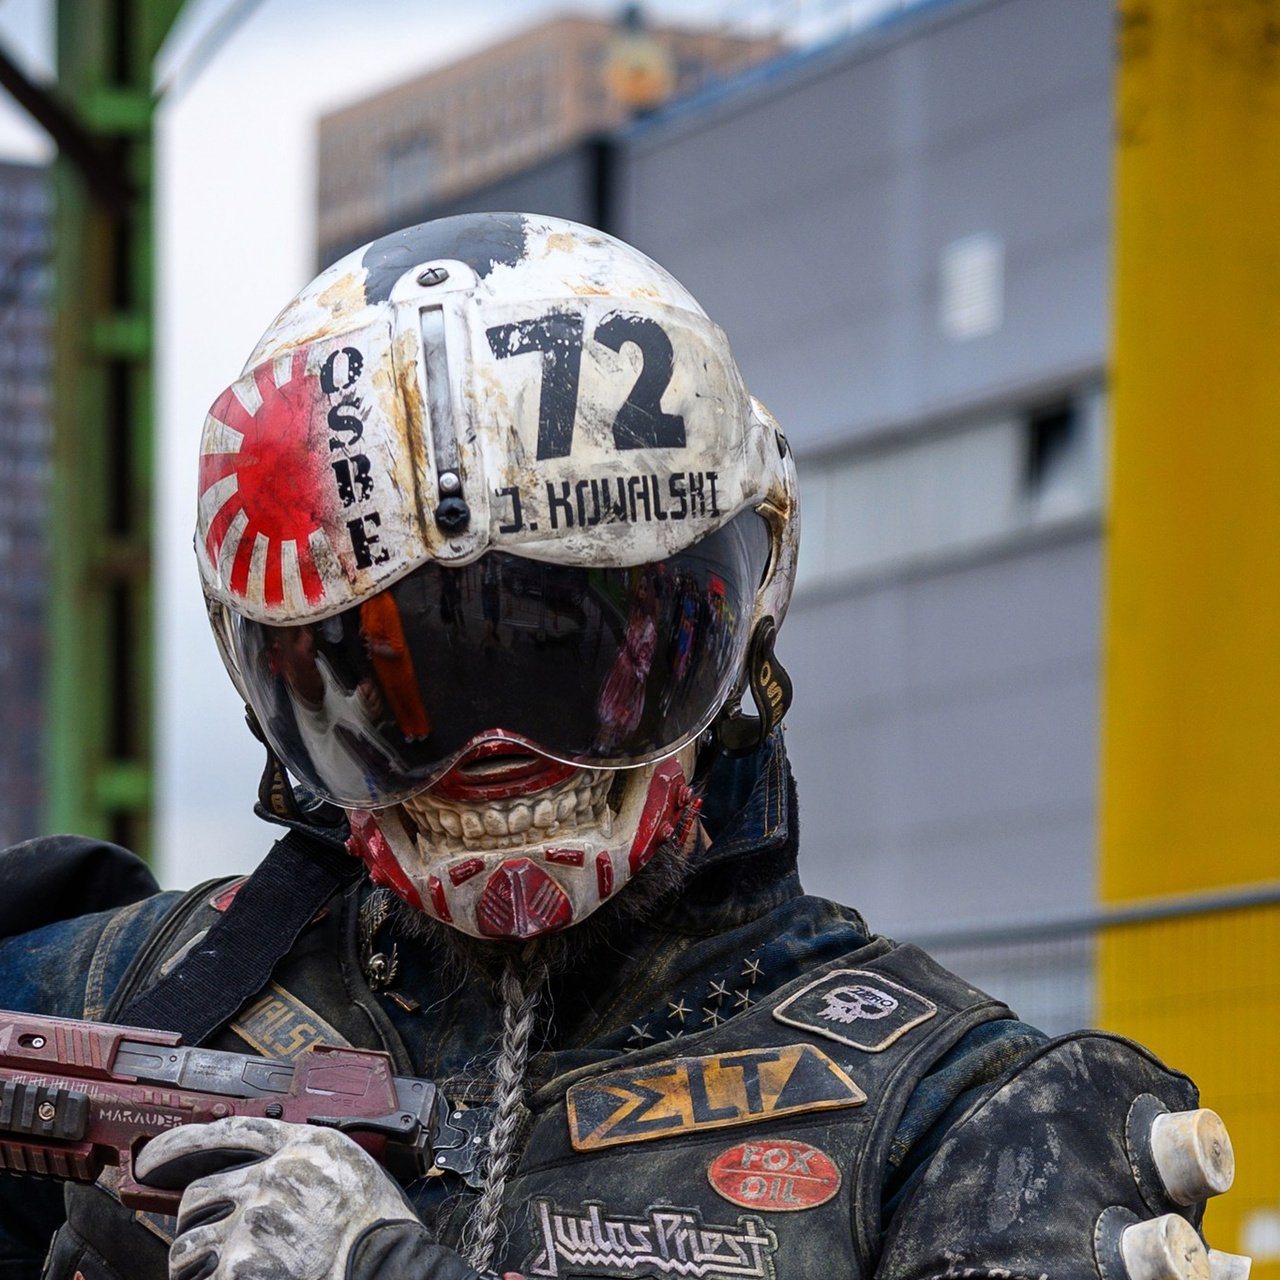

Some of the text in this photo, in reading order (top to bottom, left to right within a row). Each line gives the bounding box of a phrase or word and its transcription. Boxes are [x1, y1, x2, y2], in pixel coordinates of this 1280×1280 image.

[486, 311, 688, 461] 72
[494, 471, 721, 534] J. KOWALSKI
[99, 1108, 183, 1128] MARAUDER
[740, 1145, 816, 1176] FOX
[739, 1175, 804, 1205] OIL
[530, 1202, 772, 1278] Judas Priest
